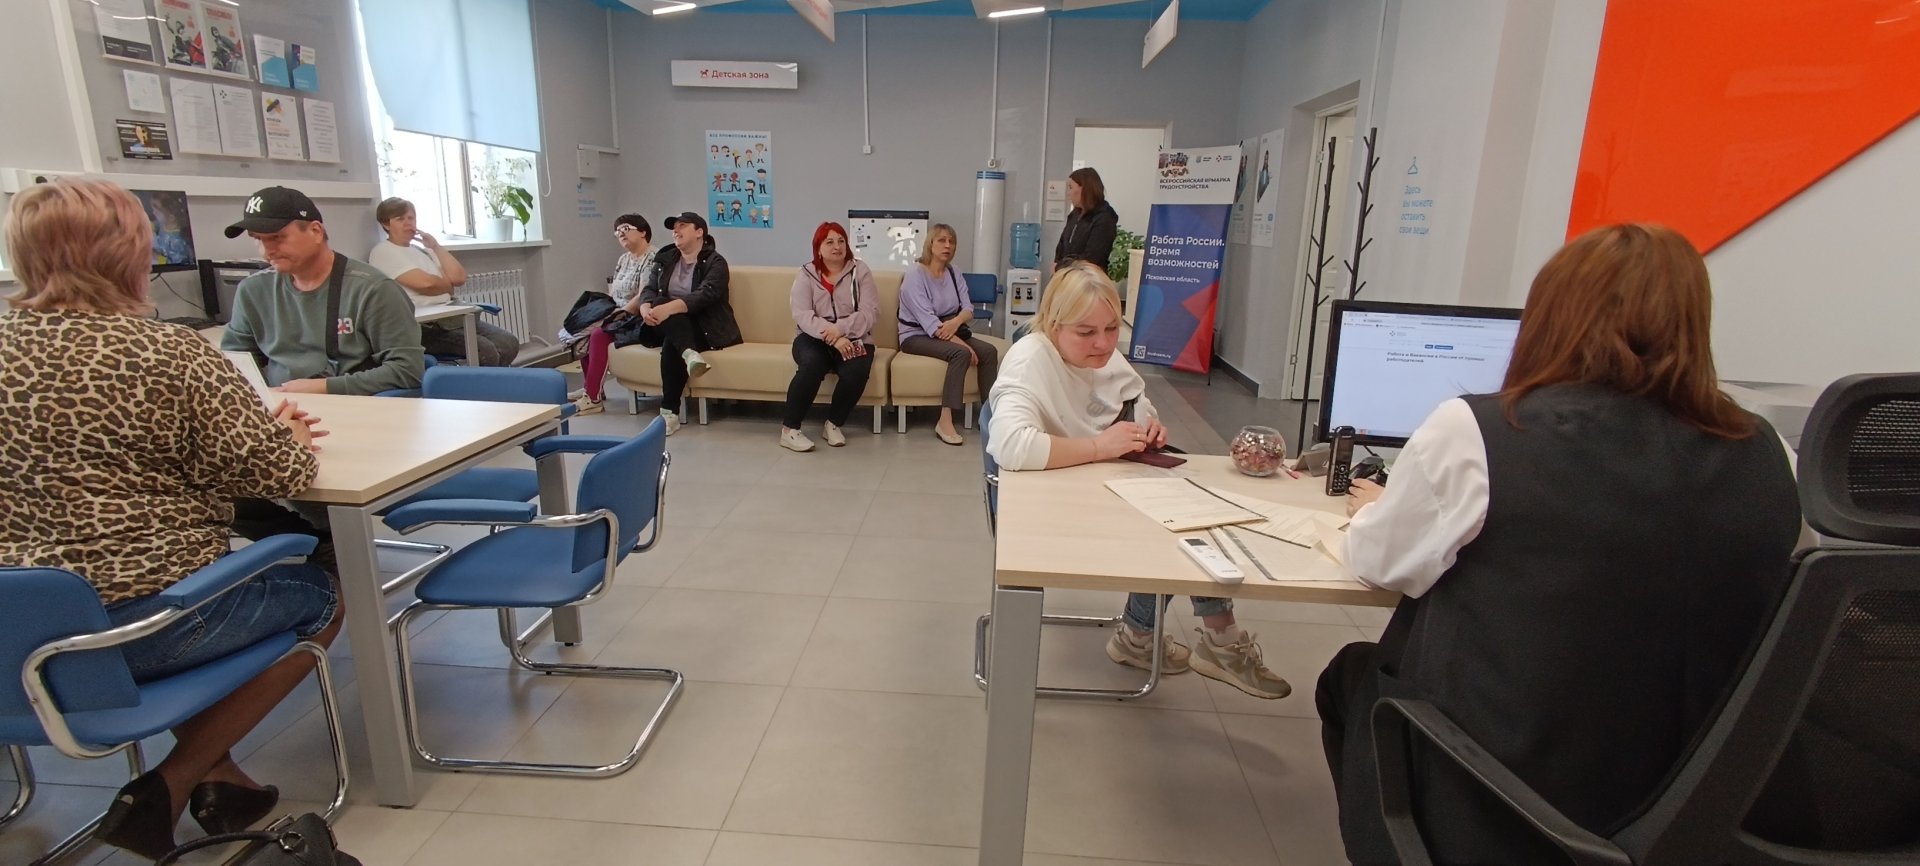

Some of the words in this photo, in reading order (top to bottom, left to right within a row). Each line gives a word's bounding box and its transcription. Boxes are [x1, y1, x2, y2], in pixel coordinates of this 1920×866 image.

[711, 70, 747, 79] Детская
[749, 71, 769, 79] зона
[245, 196, 263, 214] NY
[1151, 235, 1184, 245] Работа
[1185, 236, 1225, 247] России.
[1149, 246, 1181, 257] Время
[1147, 258, 1219, 269] возможностей
[1145, 274, 1176, 282] Псковская
[1176, 276, 1200, 284] область
